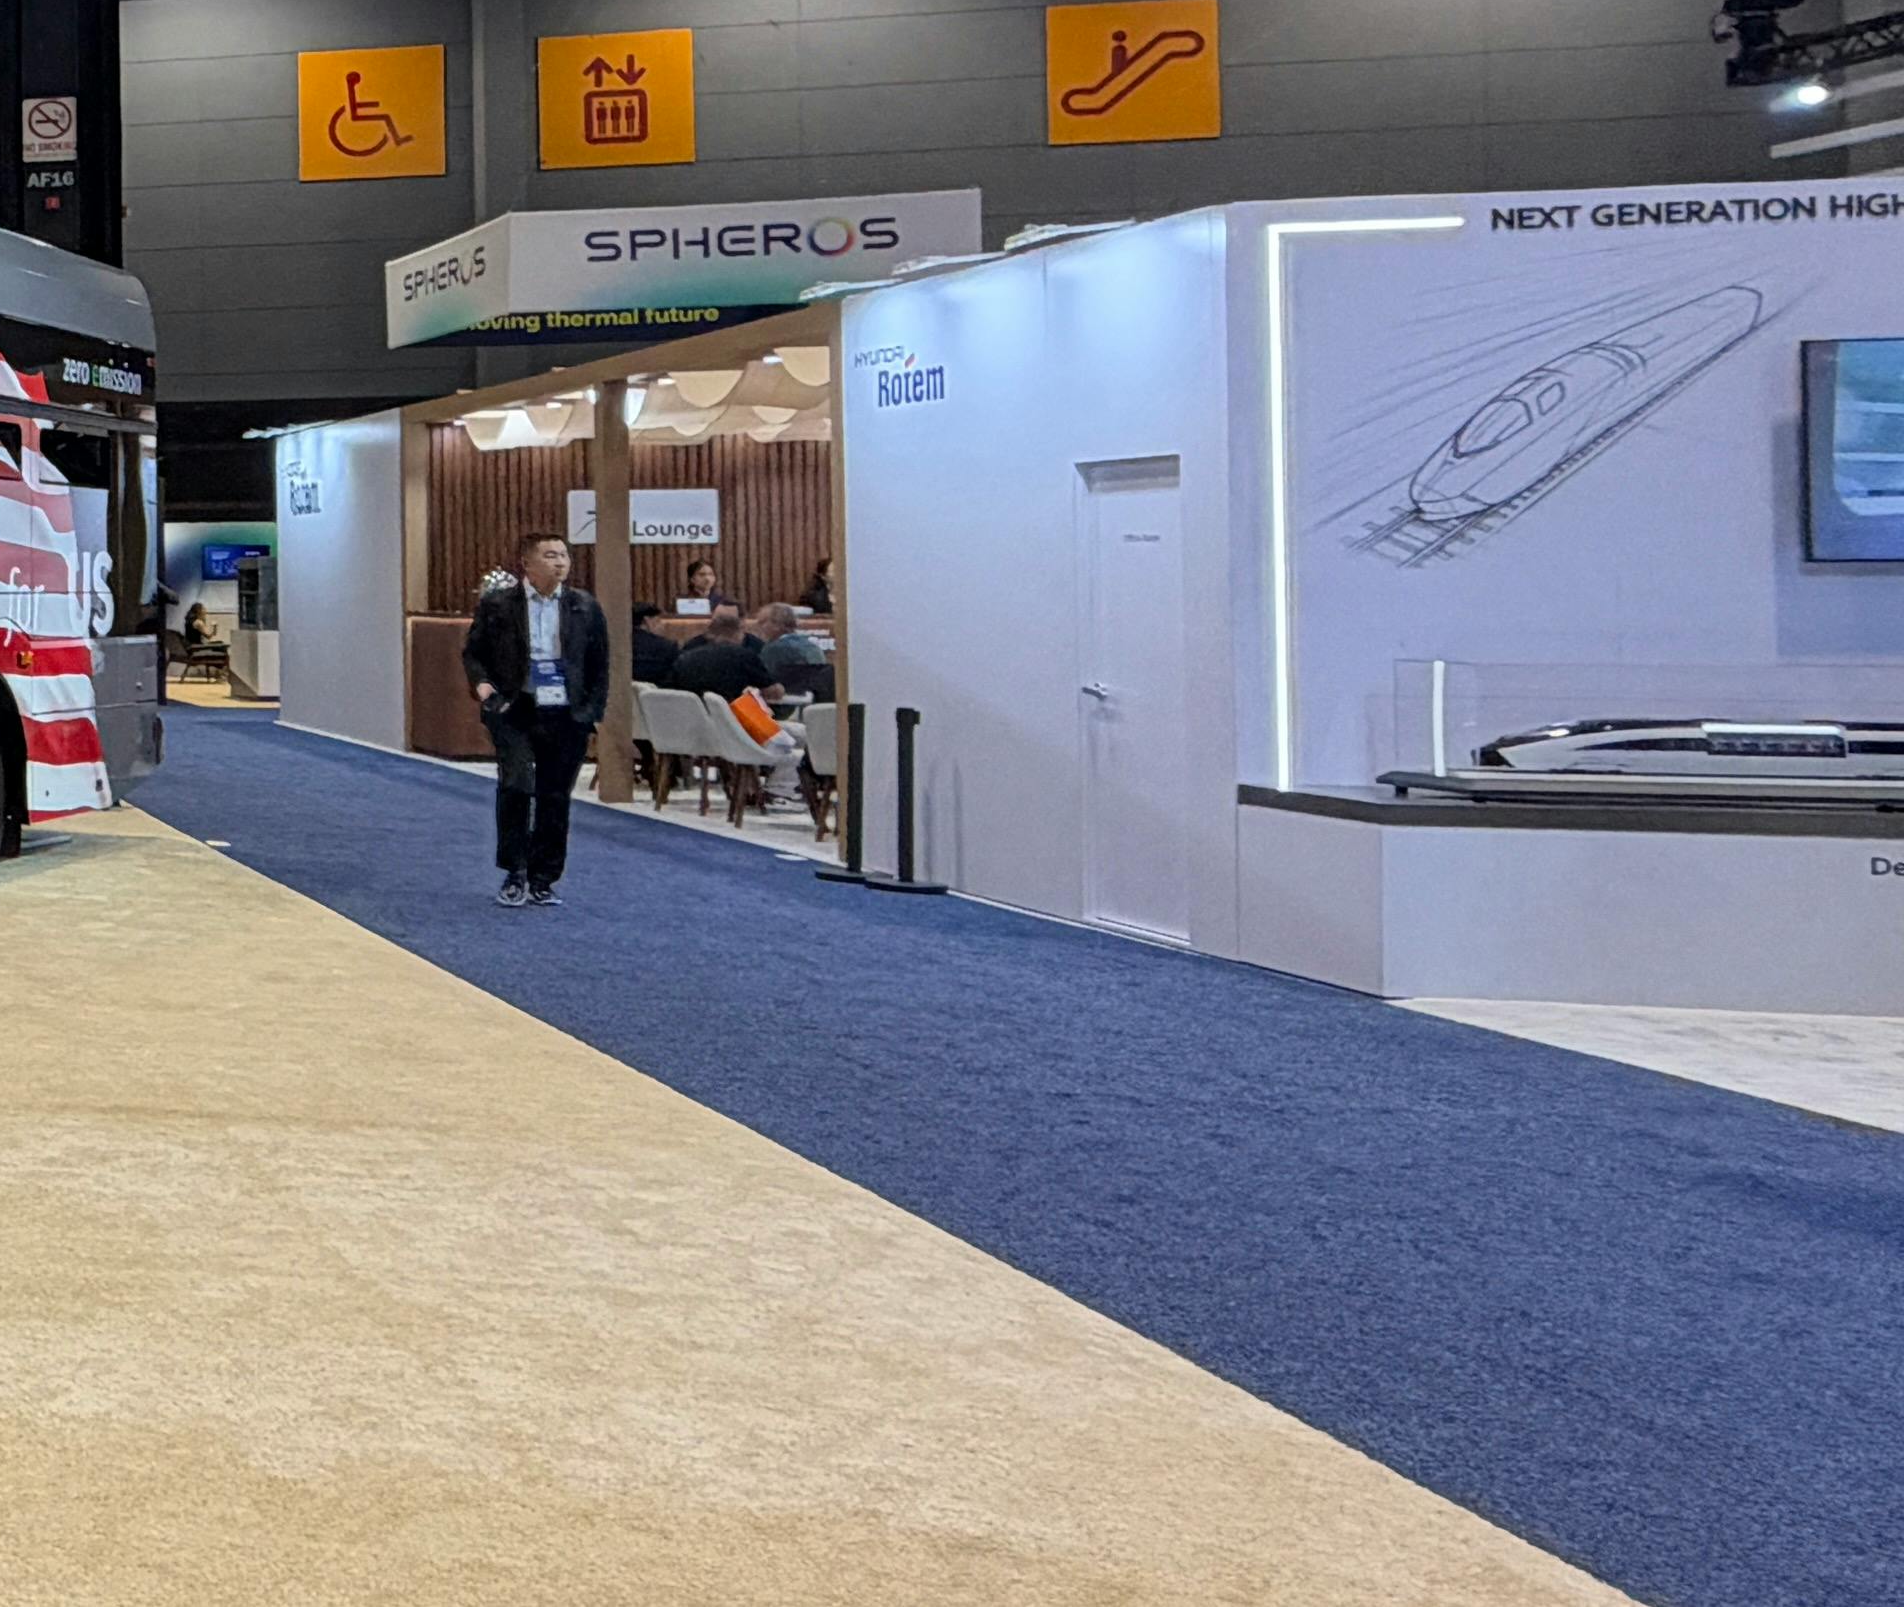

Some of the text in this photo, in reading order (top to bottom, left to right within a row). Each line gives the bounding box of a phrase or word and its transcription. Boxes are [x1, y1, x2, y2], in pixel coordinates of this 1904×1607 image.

[26, 170, 76, 189] AF16
[1491, 193, 1904, 230] NEXT GENERATION HIGH
[585, 216, 901, 263] SPHEROS
[472, 306, 720, 333] oving thermal future
[62, 357, 90, 385] zero
[878, 365, 945, 408] Rotem
[632, 520, 714, 539] Lounge
[3, 565, 45, 647] for
[68, 550, 114, 637] US
